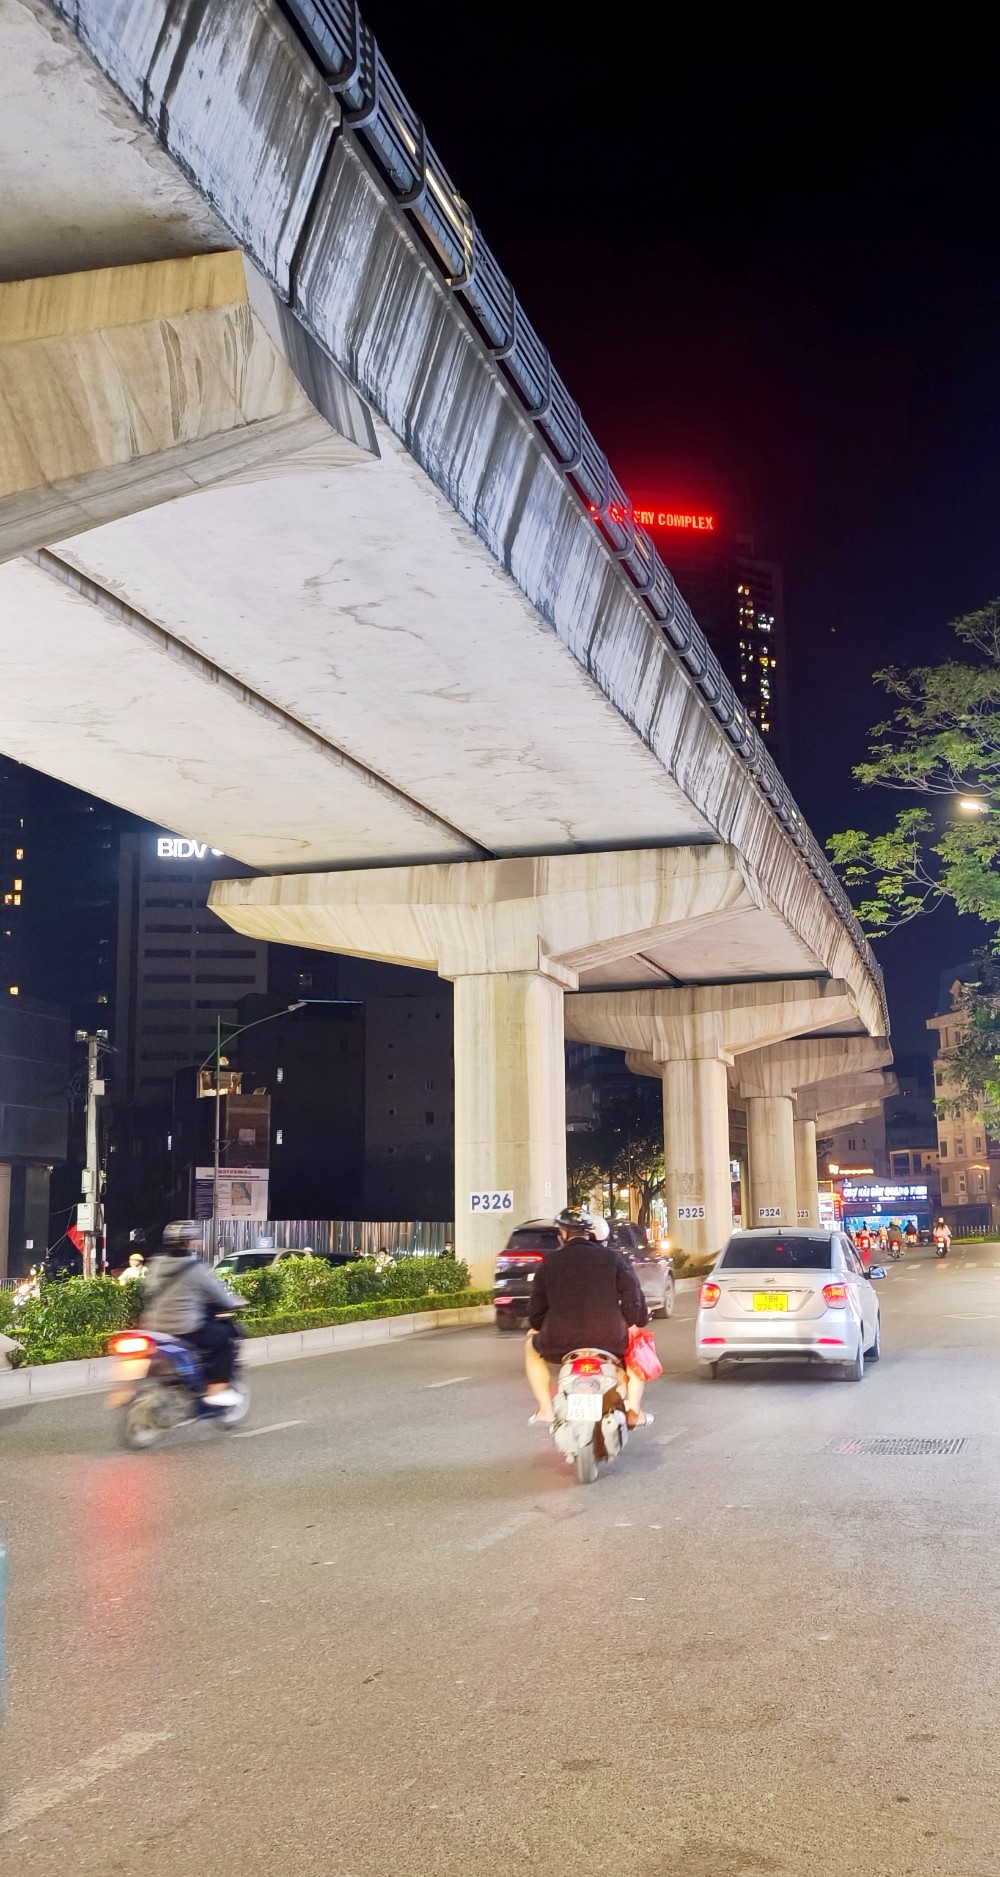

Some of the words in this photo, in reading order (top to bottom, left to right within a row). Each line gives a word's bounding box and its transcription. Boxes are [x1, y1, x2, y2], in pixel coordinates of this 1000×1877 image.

[658, 513, 714, 530] COMPLEX
[157, 838, 207, 859] BIDV
[471, 1193, 512, 1211] P326
[677, 1207, 705, 1218] P325
[759, 1208, 780, 1217] P324
[797, 1210, 809, 1218] 323
